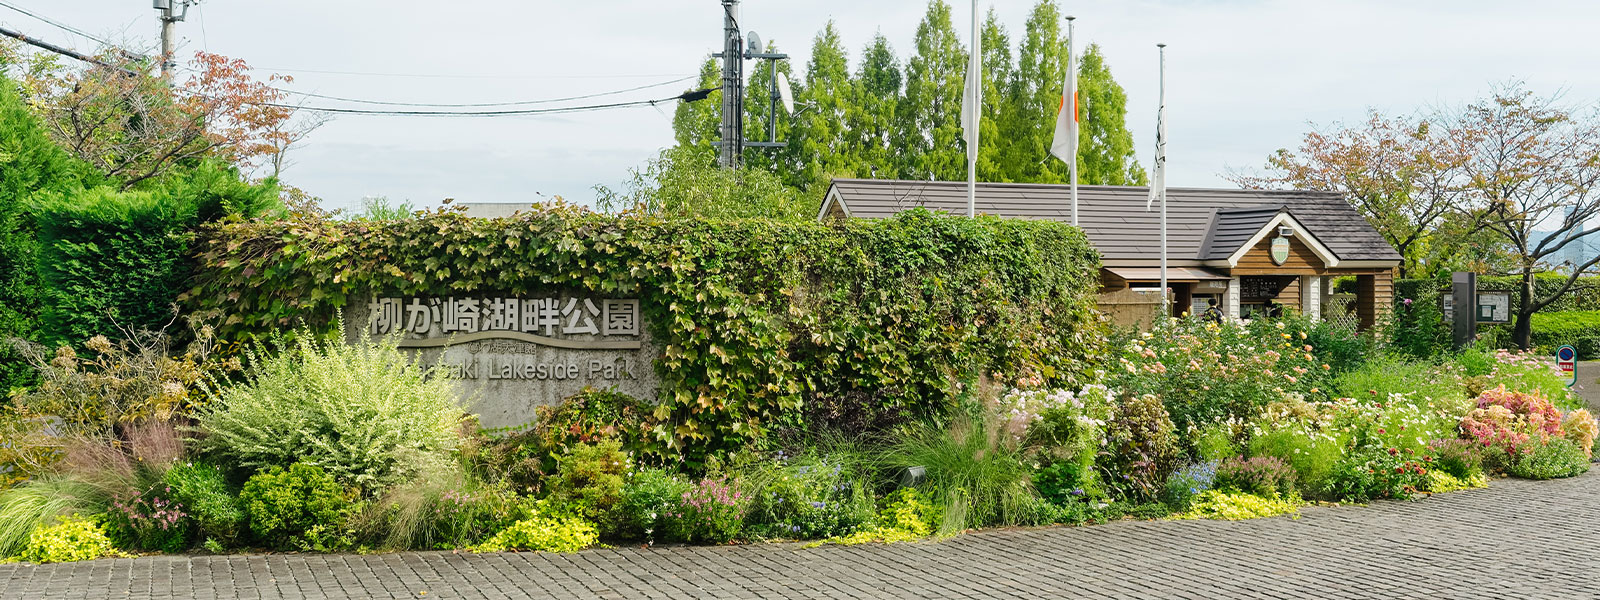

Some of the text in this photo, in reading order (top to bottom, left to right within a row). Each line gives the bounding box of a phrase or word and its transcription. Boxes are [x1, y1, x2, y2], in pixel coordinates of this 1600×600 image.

[369, 297, 640, 336] 柳が崎湖畔公園
[489, 360, 579, 380] Lakeside
[588, 359, 638, 380] Park
